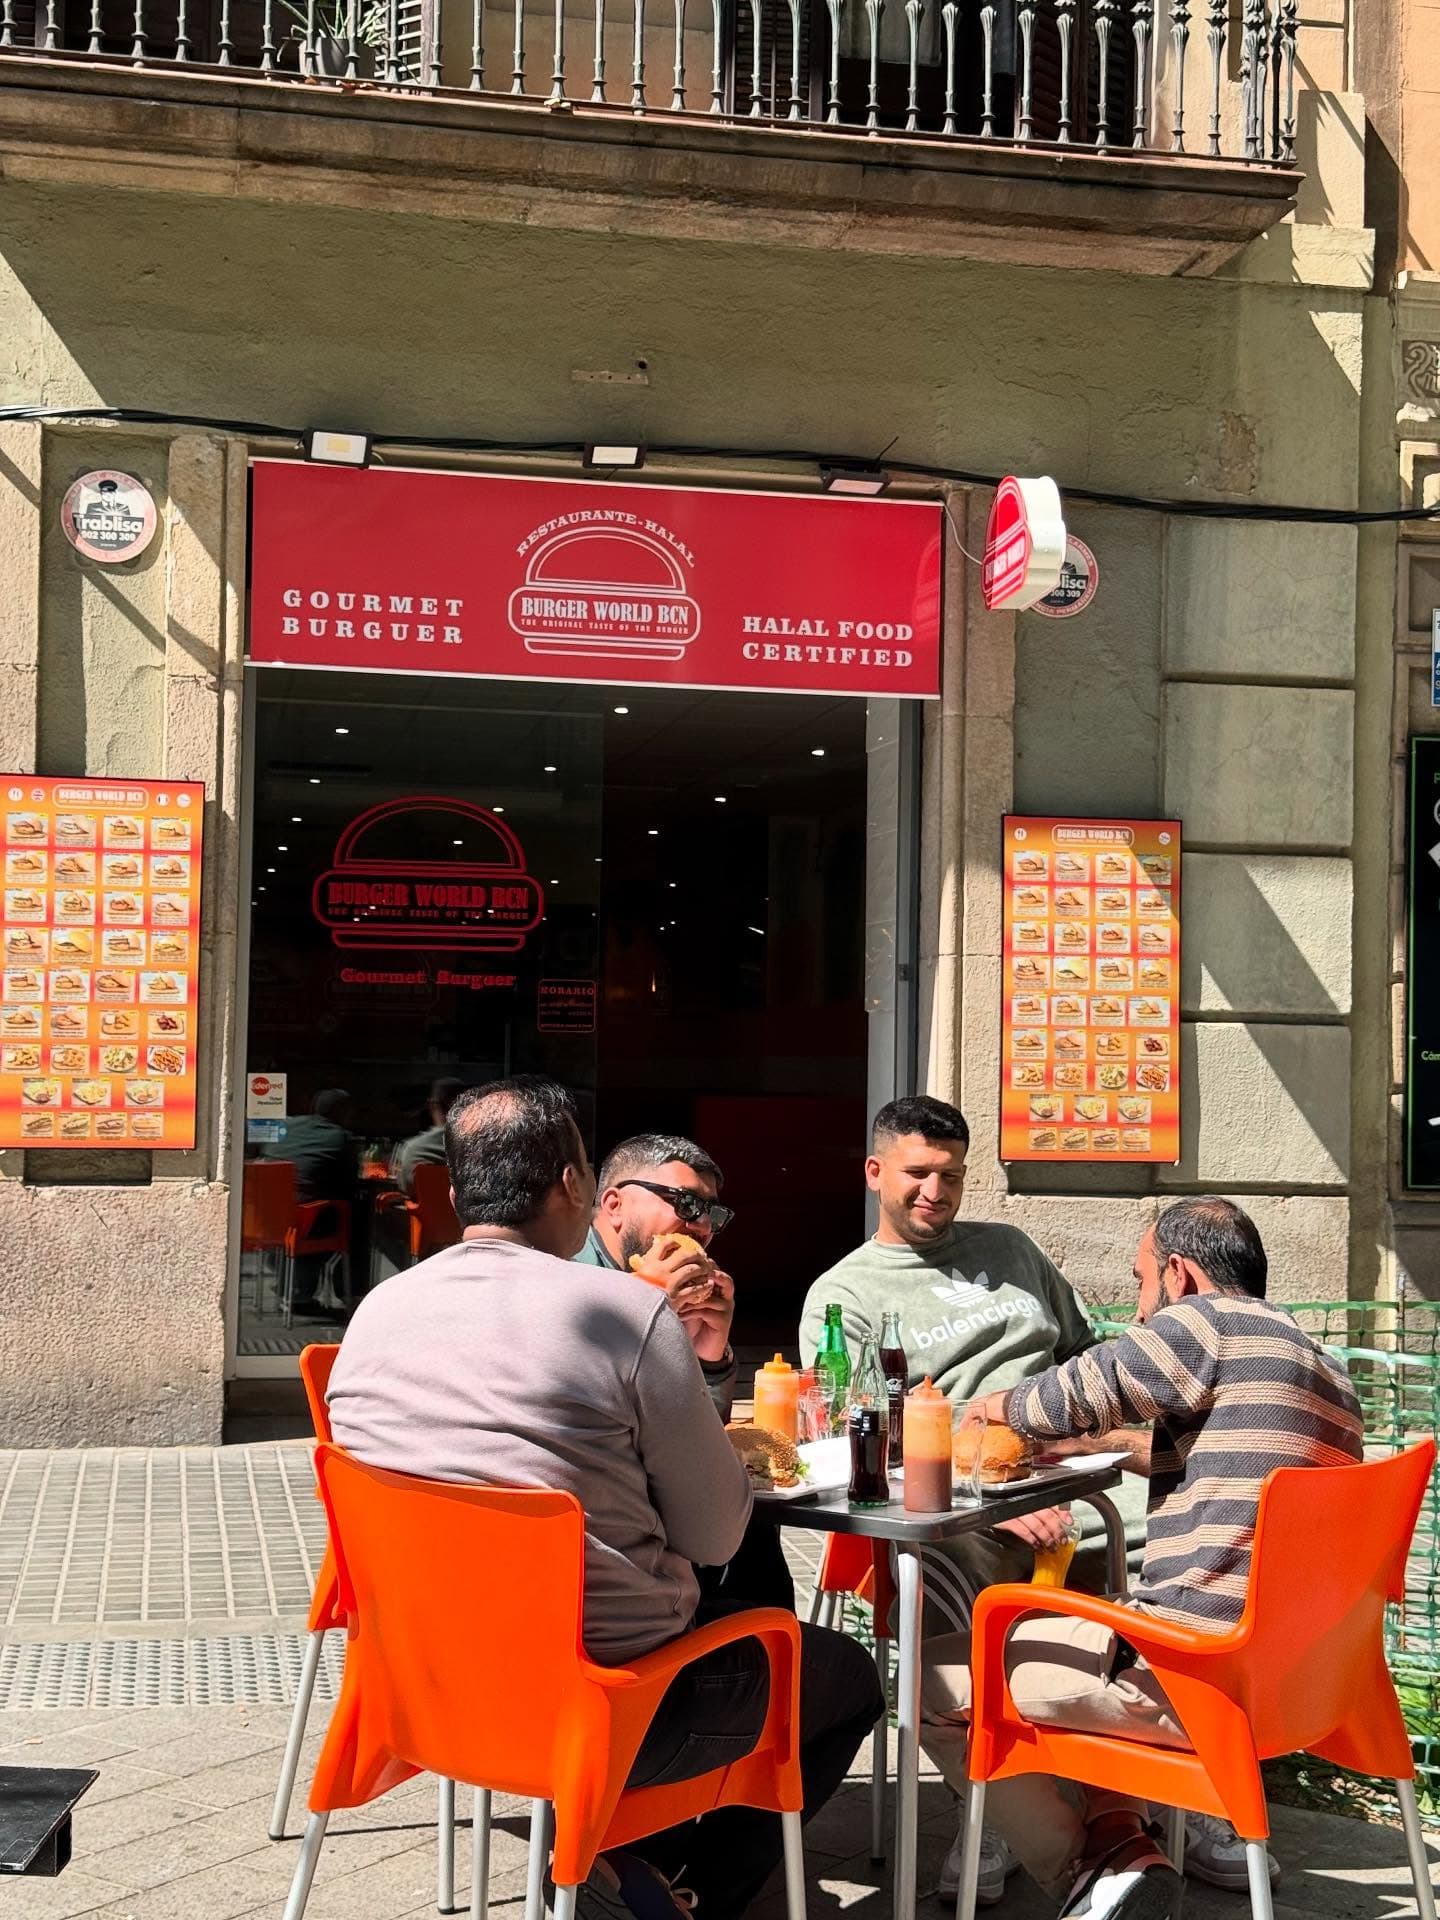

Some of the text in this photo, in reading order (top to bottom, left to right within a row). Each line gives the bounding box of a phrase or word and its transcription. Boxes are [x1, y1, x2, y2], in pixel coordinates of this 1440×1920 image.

[74, 515, 143, 533] Trablisa
[80, 530, 137, 542] 902 300 309
[282, 588, 463, 617] GOURMET
[520, 596, 689, 625] BURGER WORLD BCN
[281, 616, 463, 644] BURGUER
[742, 615, 913, 641] HALAL FOOD
[742, 642, 913, 667] CERTIFIED
[327, 881, 529, 909] BURGER WORLD BCN
[340, 967, 428, 984] Gourmet
